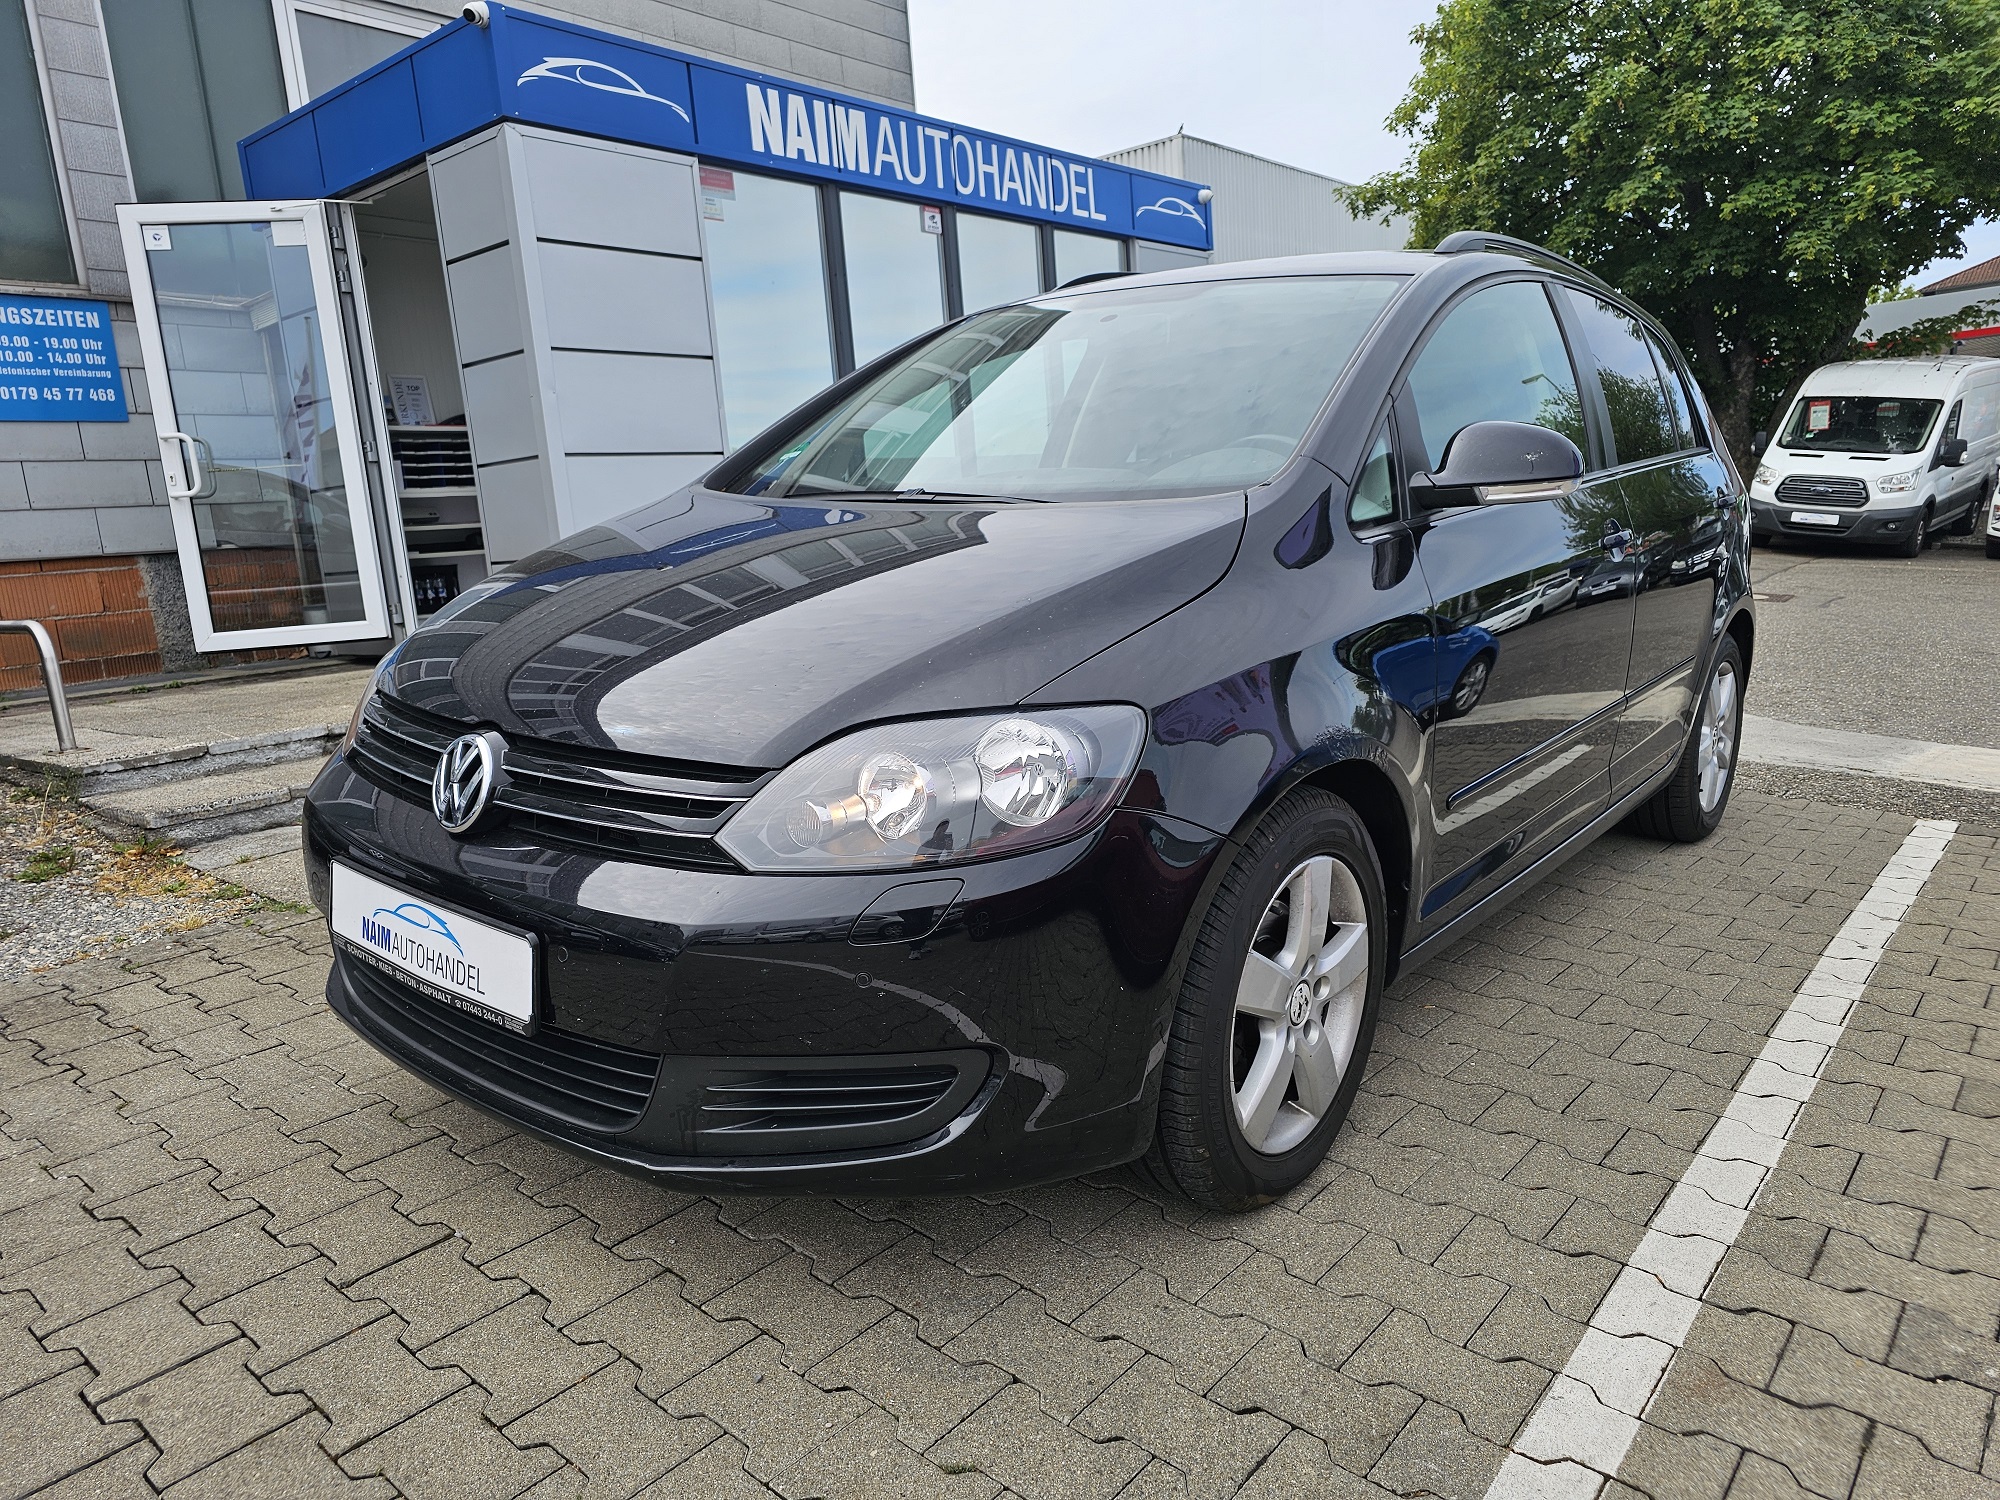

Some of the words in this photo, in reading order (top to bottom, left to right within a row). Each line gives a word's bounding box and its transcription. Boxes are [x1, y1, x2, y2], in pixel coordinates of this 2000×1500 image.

[746, 83, 870, 174] NAIM
[873, 116, 1107, 222] AUTOHANDEL
[0, 335, 30, 348] 9.00
[43, 337, 78, 350] 19.00
[82, 339, 103, 351] Uhr
[47, 352, 82, 364] 14.00
[85, 354, 107, 365] Uhr
[53, 368, 112, 379] Vereinbarung
[0, 386, 38, 401] 0179
[43, 387, 62, 401] 45
[65, 388, 83, 401] 77
[89, 388, 116, 402] 468
[362, 915, 391, 953] NAIM
[392, 932, 486, 995] AUTOHANDEL
[462, 1001, 482, 1017] 07443
[483, 1010, 503, 1026] 244-0
